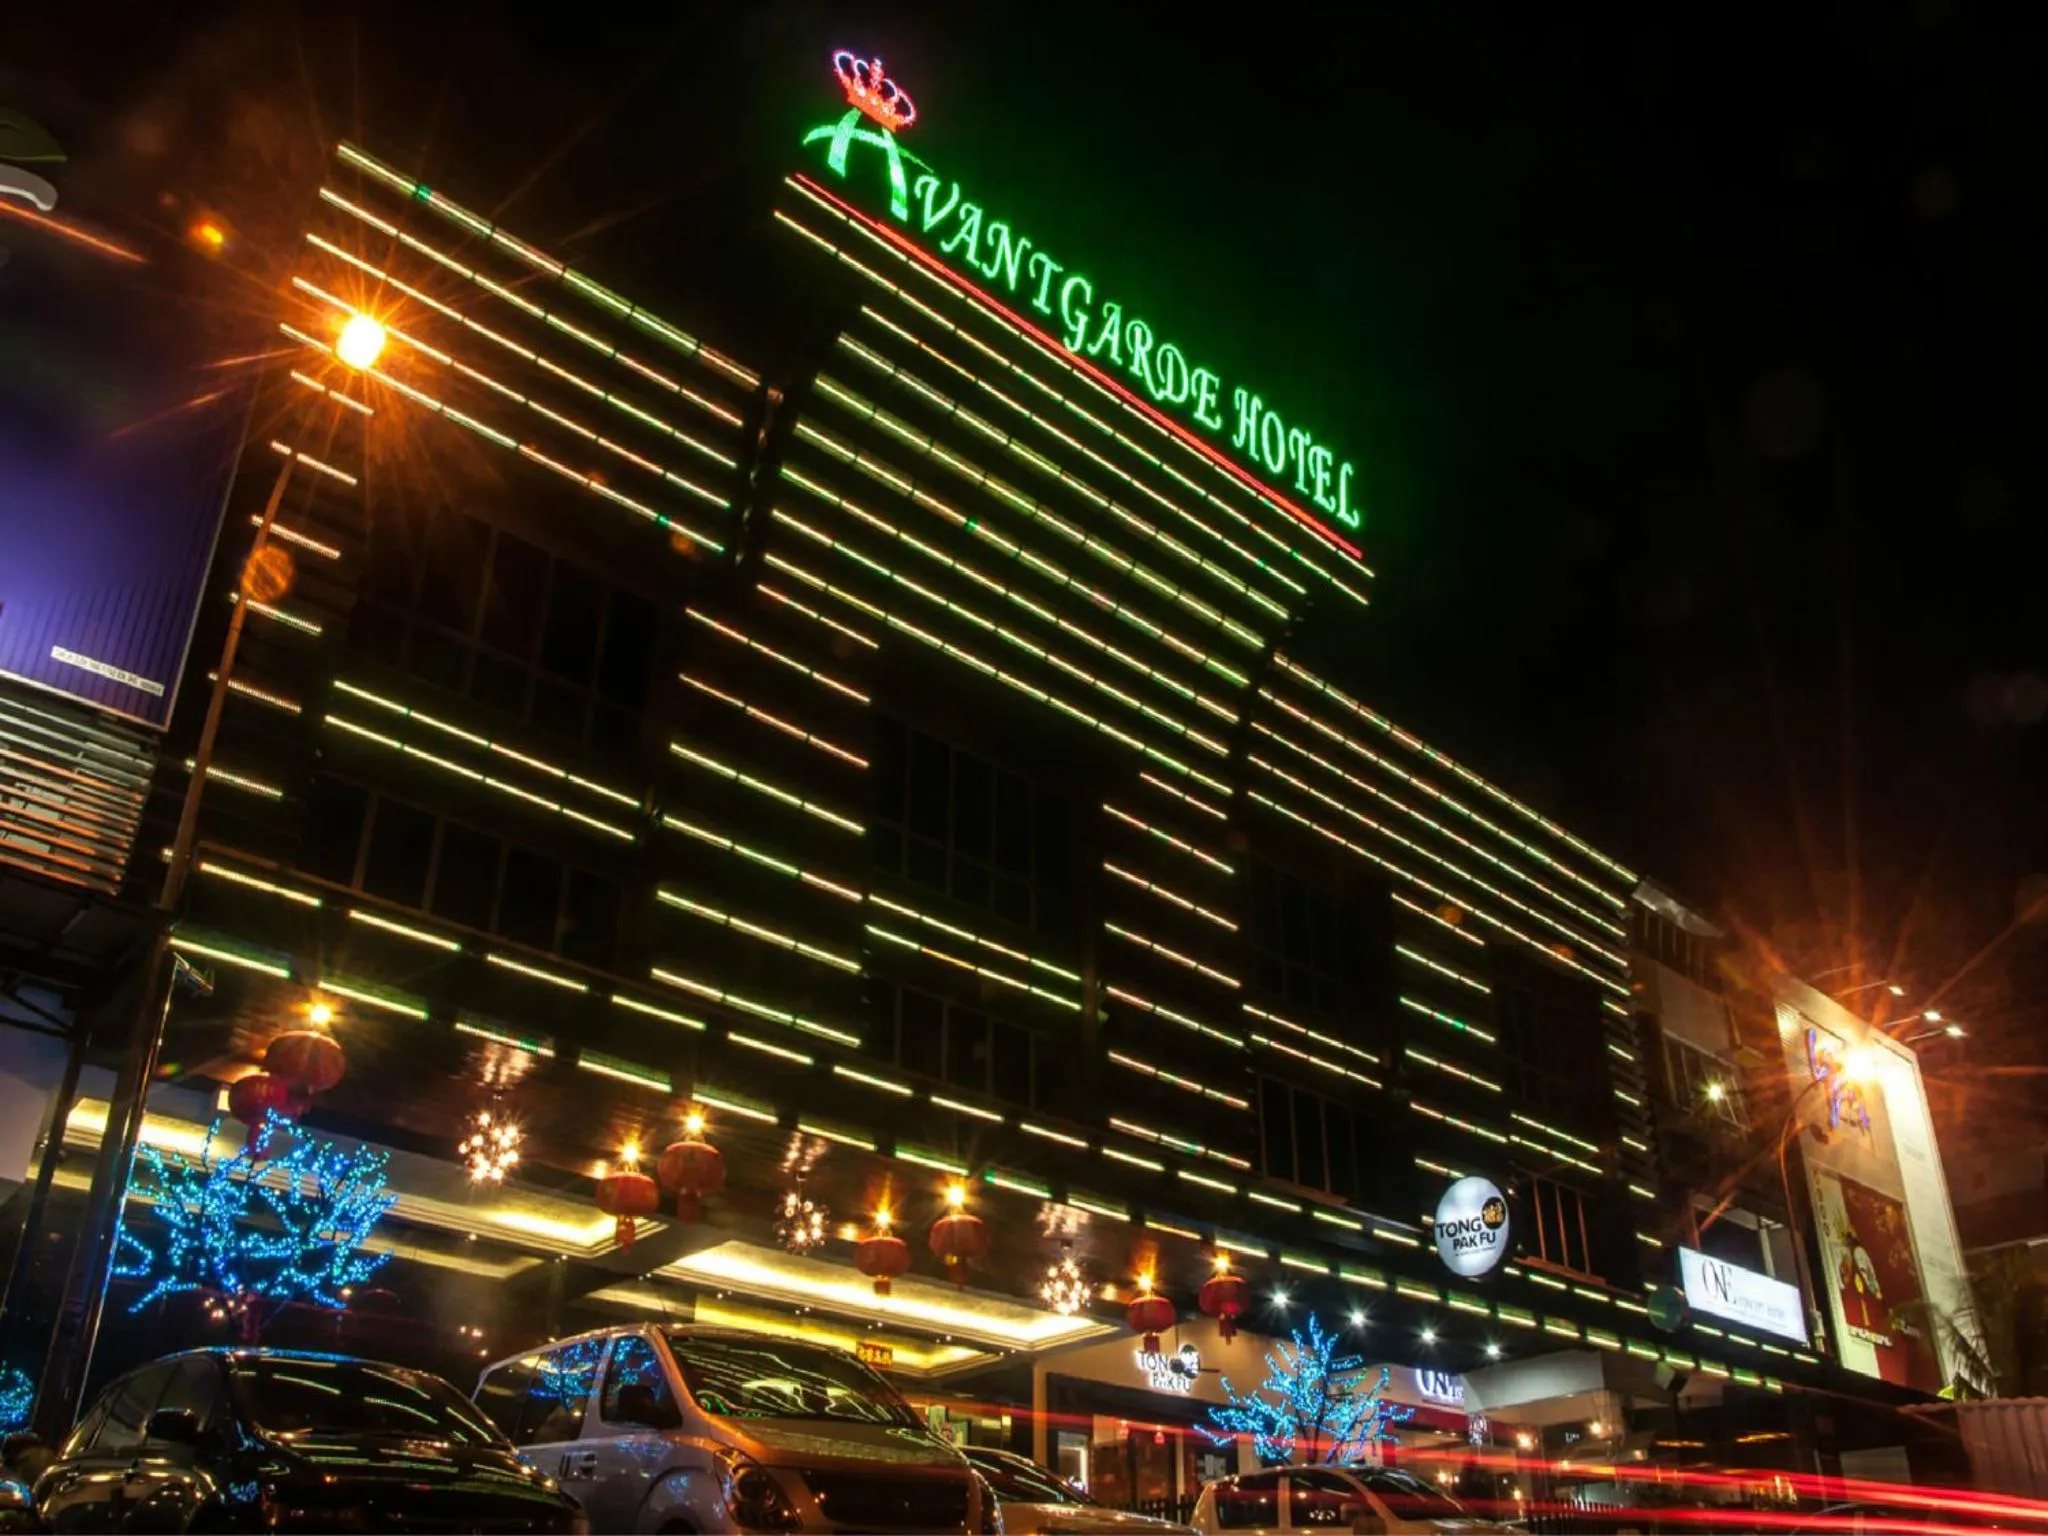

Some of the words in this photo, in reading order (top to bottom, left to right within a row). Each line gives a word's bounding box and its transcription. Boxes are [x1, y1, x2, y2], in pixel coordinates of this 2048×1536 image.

[803, 107, 1221, 430] AVANTGARDE
[1232, 386, 1360, 528] HOTEL
[1436, 1217, 1482, 1239] TONG
[1453, 1235, 1478, 1251] PAK
[1480, 1232, 1496, 1244] FU
